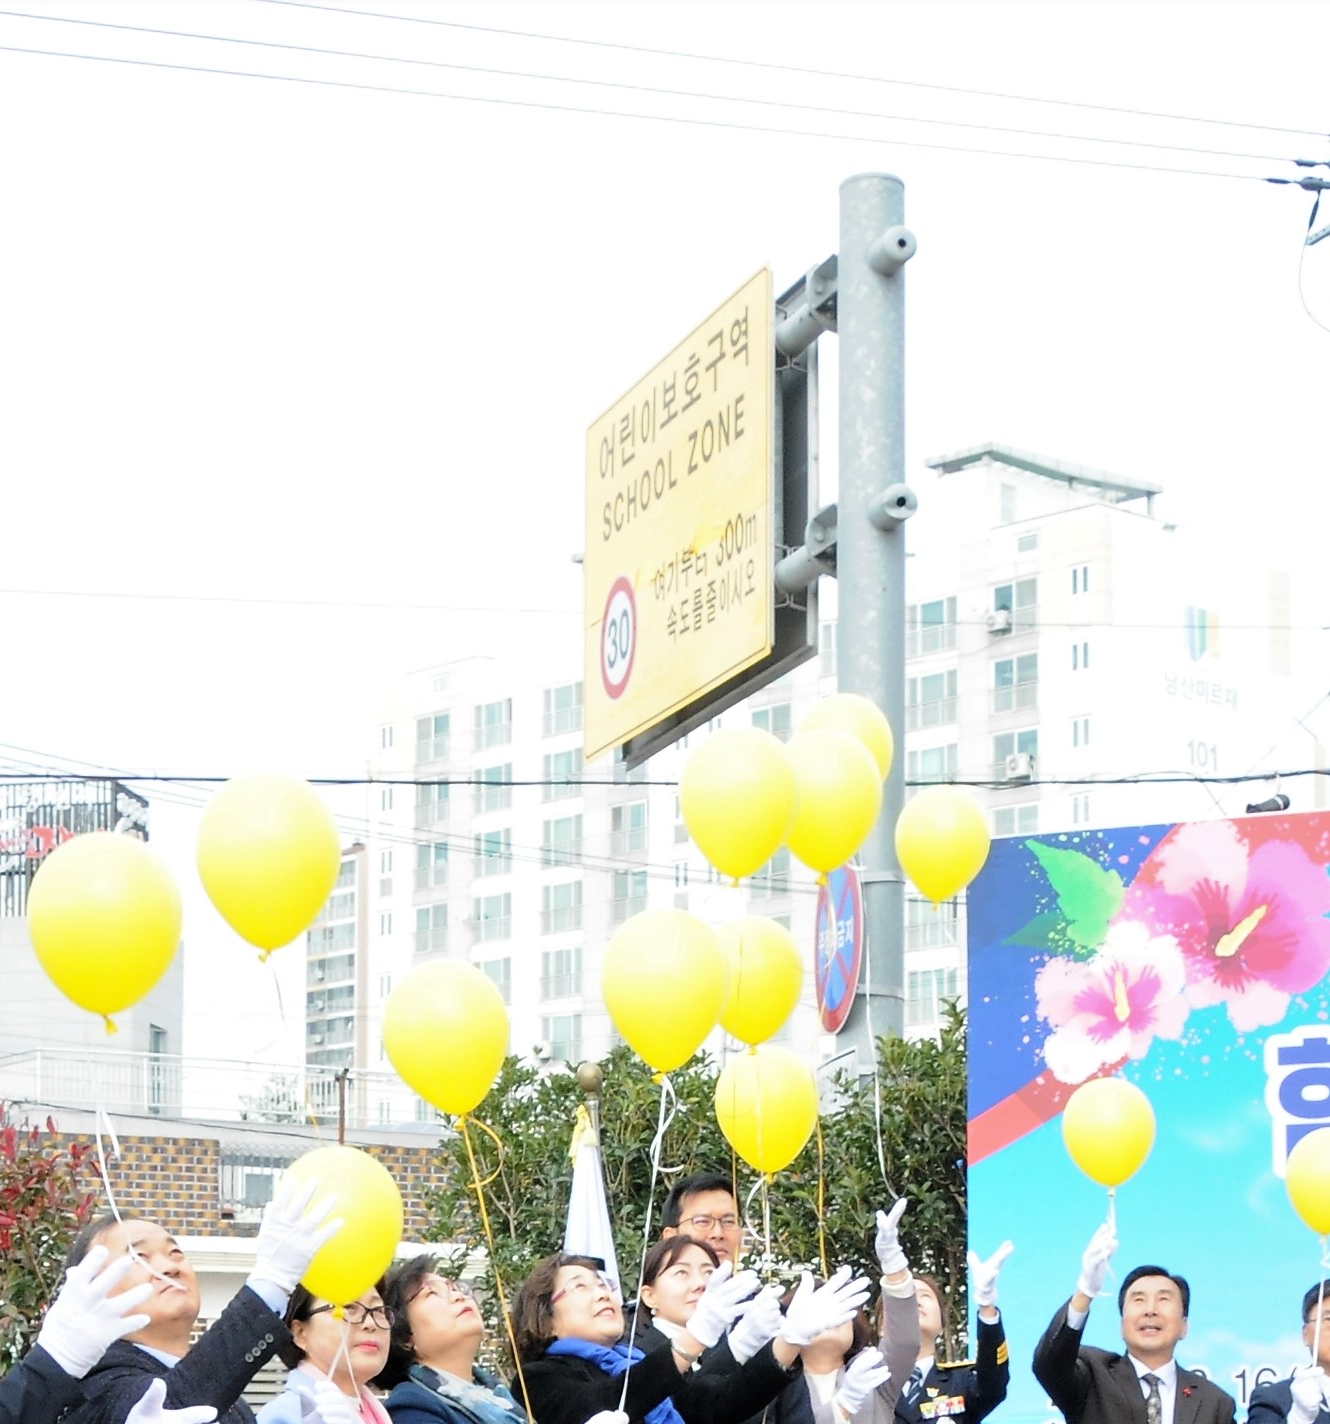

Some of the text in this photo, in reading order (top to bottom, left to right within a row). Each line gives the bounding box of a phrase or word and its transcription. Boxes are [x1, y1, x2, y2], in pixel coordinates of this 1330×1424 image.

[600, 306, 749, 479] 어린이보호구역
[602, 393, 745, 541] SCHOOL ZONE
[607, 608, 630, 669] 30
[1186, 738, 1217, 772] 101
